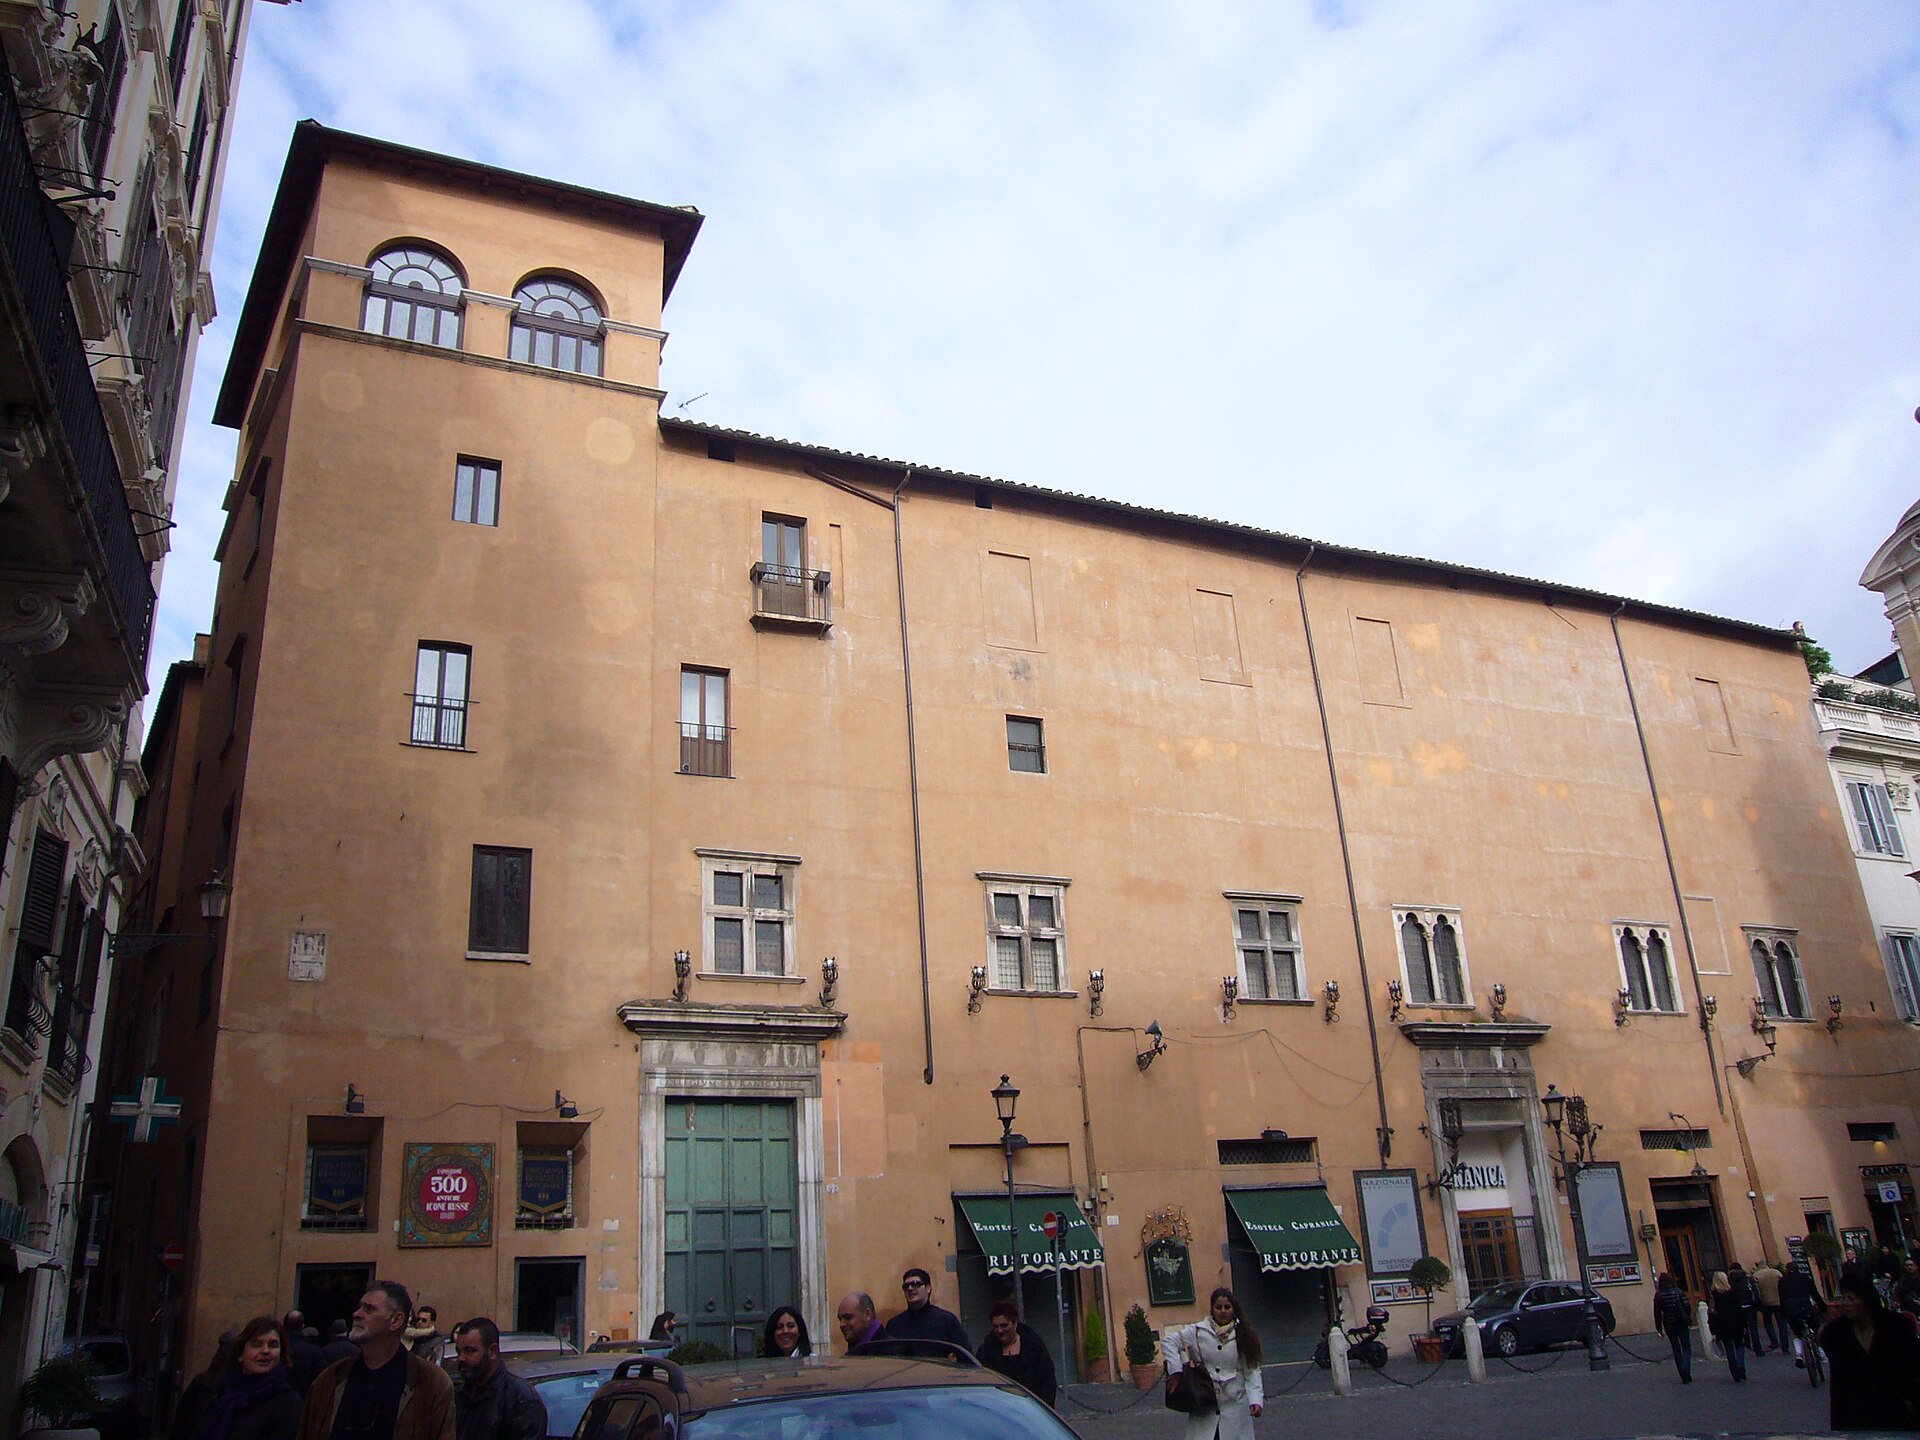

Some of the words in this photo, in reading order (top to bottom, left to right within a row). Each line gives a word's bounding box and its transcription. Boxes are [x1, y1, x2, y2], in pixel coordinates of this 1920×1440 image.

[431, 1176, 468, 1194] 500
[1363, 1178, 1410, 1186] NAZIONALE
[989, 1248, 1101, 1267] RITORANTE
[1263, 1247, 1359, 1264] RISTORANTE
